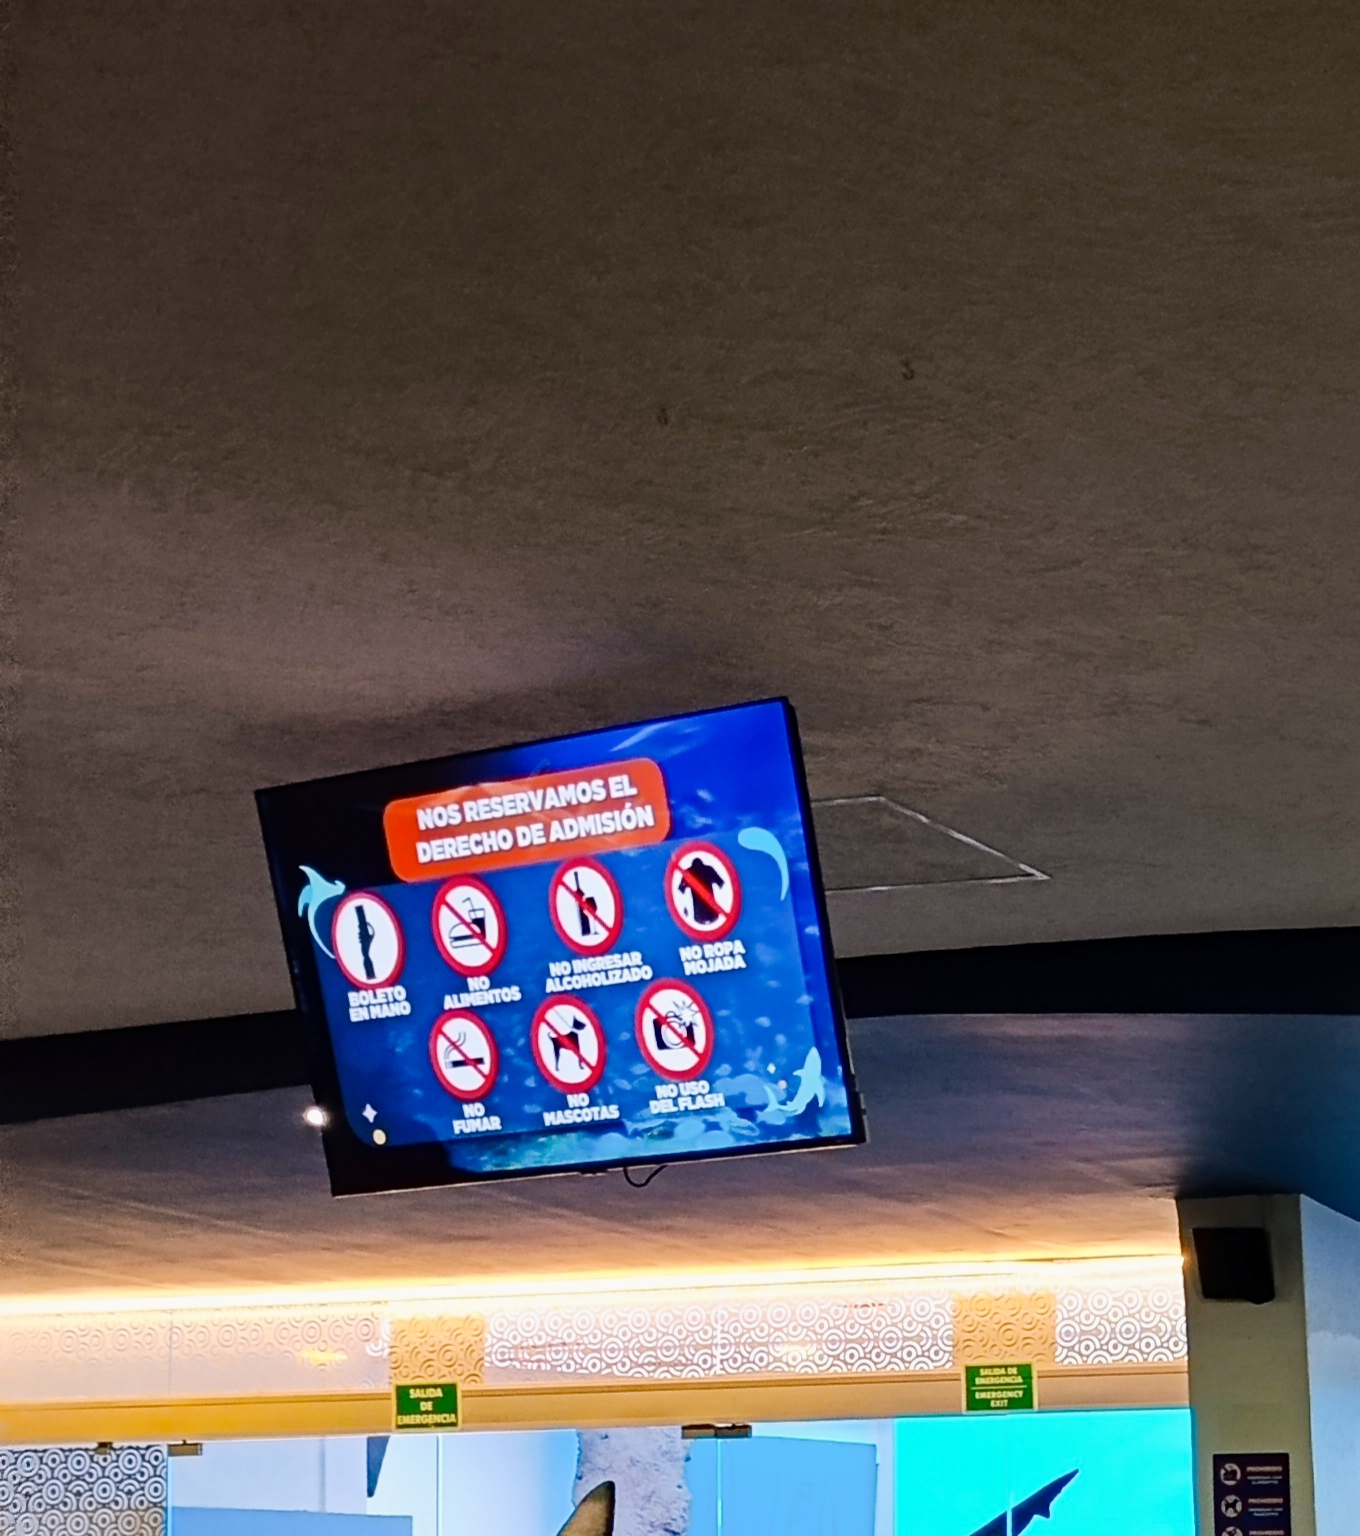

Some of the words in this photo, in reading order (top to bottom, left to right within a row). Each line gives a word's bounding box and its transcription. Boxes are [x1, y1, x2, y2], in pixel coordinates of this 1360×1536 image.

[417, 802, 462, 830] NOS
[463, 779, 607, 822] RESERVAMOS
[608, 774, 638, 798] EL
[416, 829, 513, 863] DERECHO
[516, 823, 546, 848] DE
[549, 802, 655, 842] ADMISIÓN
[679, 946, 702, 962] NO
[703, 940, 746, 959] ROPA
[549, 961, 571, 977] NO
[572, 951, 643, 972] INGRESAR
[683, 955, 747, 975] MOJADA
[467, 976, 491, 992] NO
[546, 965, 653, 993] ALCOHOLIZADO
[348, 986, 407, 1008] BOLETO
[444, 986, 522, 1010] ALIMENTOS
[349, 1005, 370, 1022] EN
[370, 1001, 411, 1020] MANO
[655, 1084, 677, 1100] NO
[679, 1080, 710, 1096] USO
[462, 1102, 486, 1118] NO
[567, 1093, 590, 1109] NO
[649, 1097, 677, 1114] DEL
[678, 1093, 726, 1111] FLASH
[453, 1116, 502, 1135] FUMAR
[543, 1105, 620, 1126] MASCOTAS
[975, 1376, 1023, 1385] EMERGENCIA
[980, 1367, 1006, 1376] SALIDA
[409, 1388, 443, 1399] SALIDA
[975, 1390, 1024, 1399] EMERGENCY
[420, 1401, 433, 1411] DE
[397, 1413, 457, 1425] EMERGENCIA
